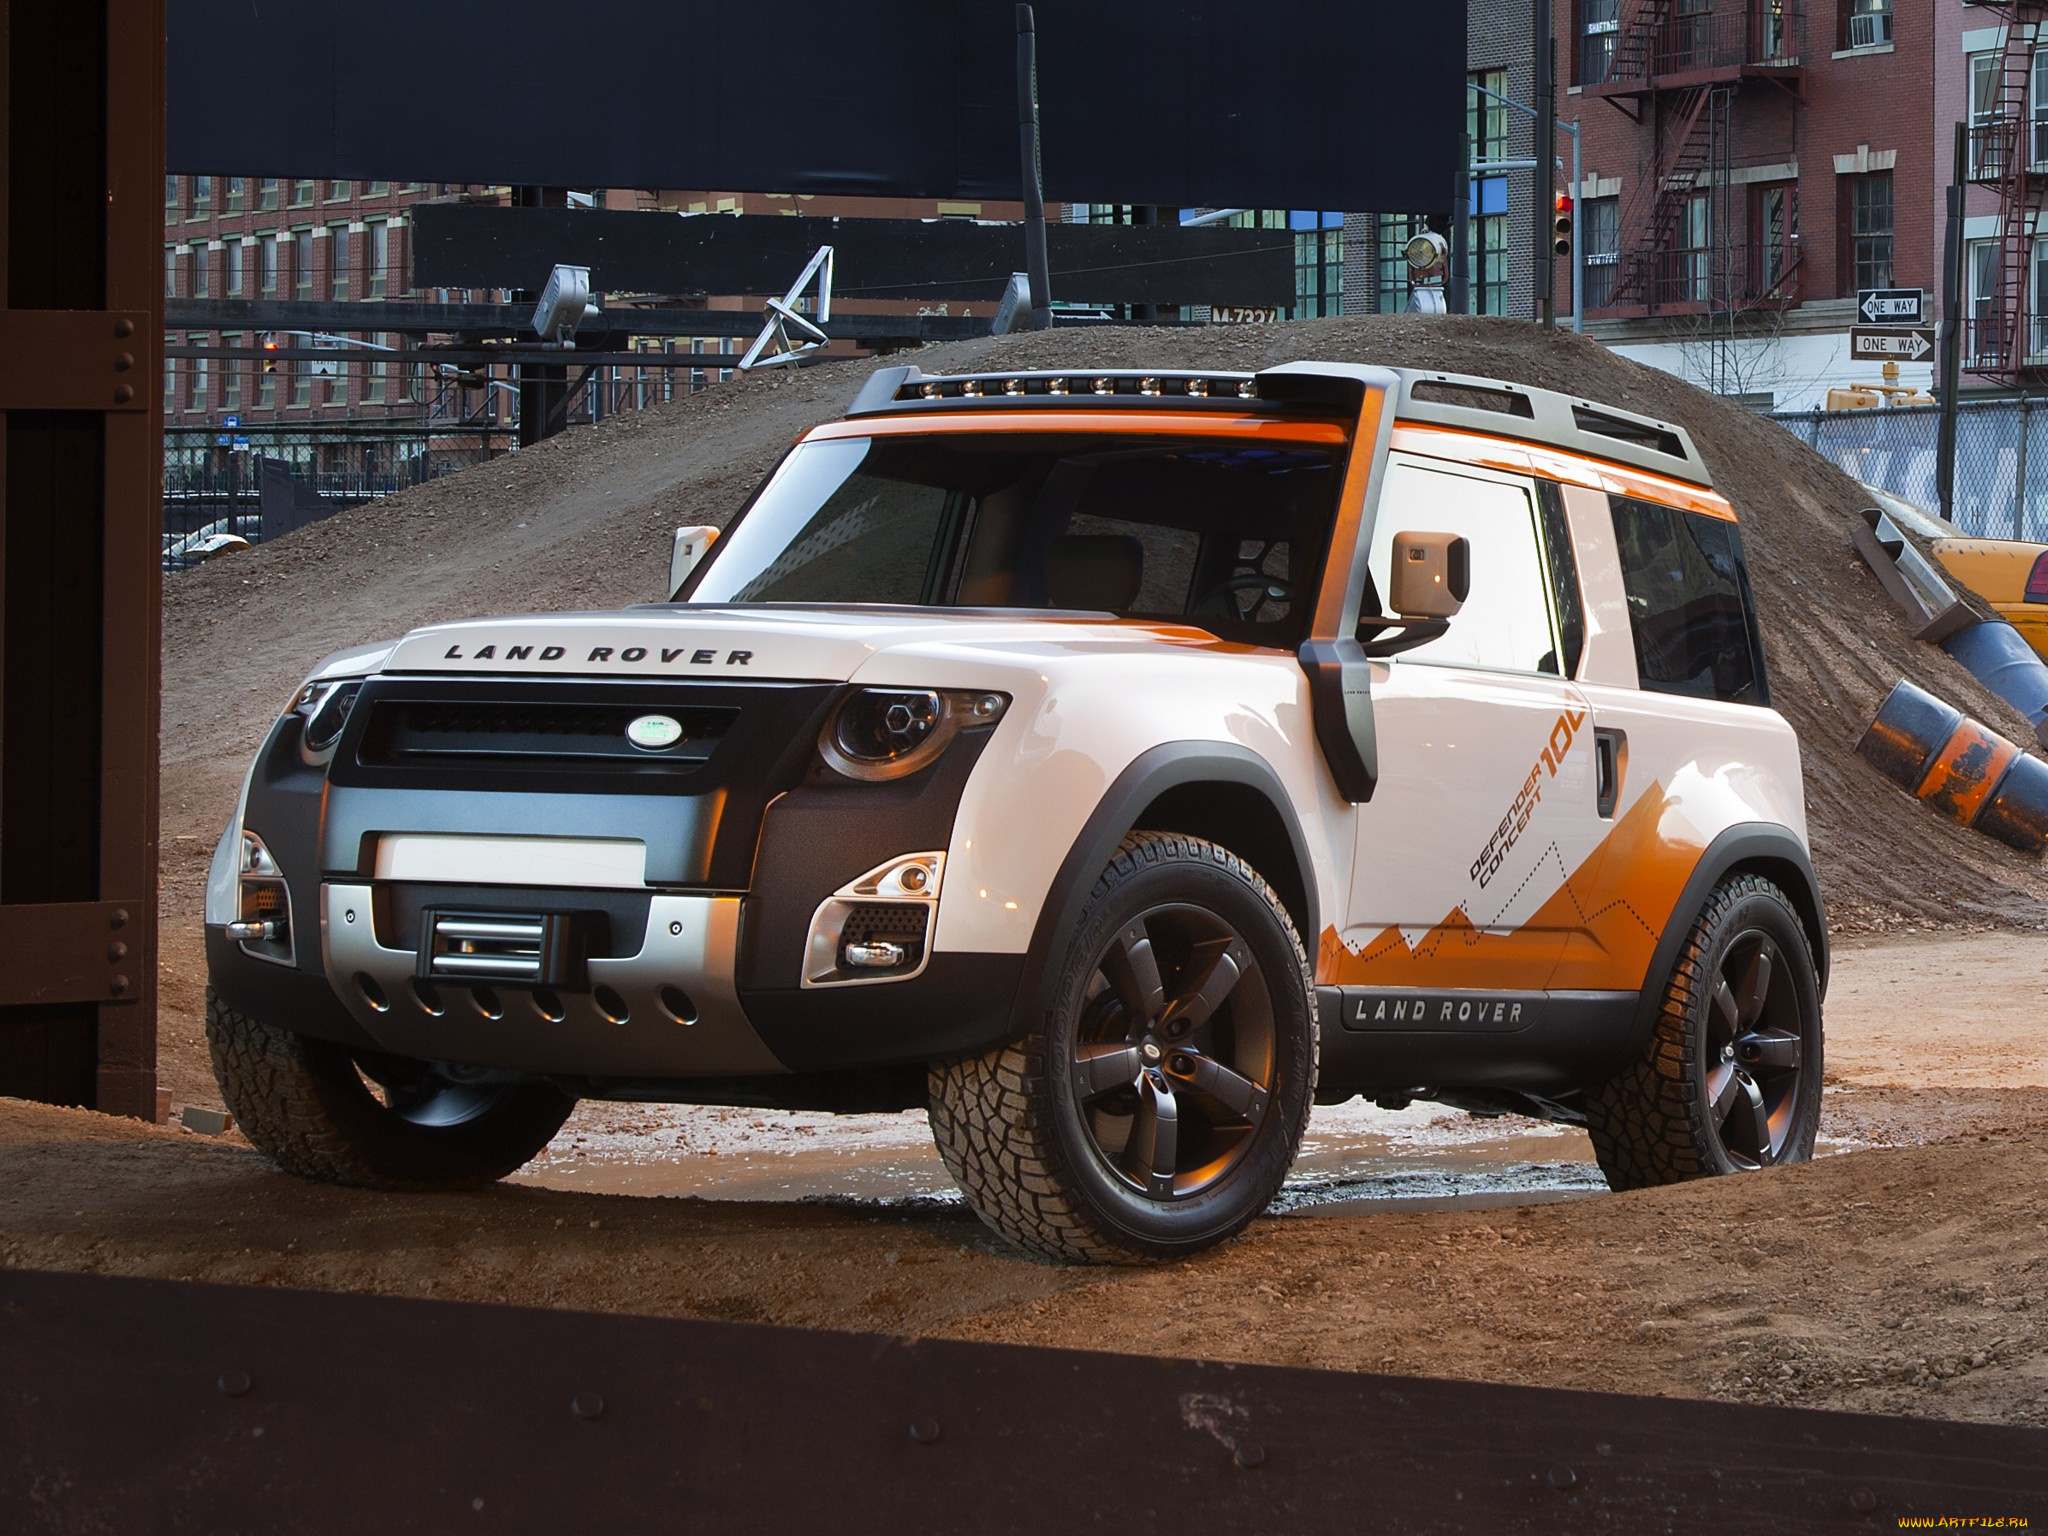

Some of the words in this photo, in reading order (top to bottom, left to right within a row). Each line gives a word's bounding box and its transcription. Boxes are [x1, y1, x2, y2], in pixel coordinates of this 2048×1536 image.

[1867, 301, 1886, 313] ONE
[1894, 300, 1914, 313] WAY
[1863, 338, 1887, 351] ONE
[1898, 339, 1923, 352] WAY
[444, 645, 567, 660] LAND
[587, 646, 754, 665] ROVER
[1469, 763, 1542, 882] DEFENDER
[1479, 786, 1542, 889] CONCEPT
[1355, 1000, 1425, 1021] LAND
[1440, 1001, 1522, 1022] ROVER
